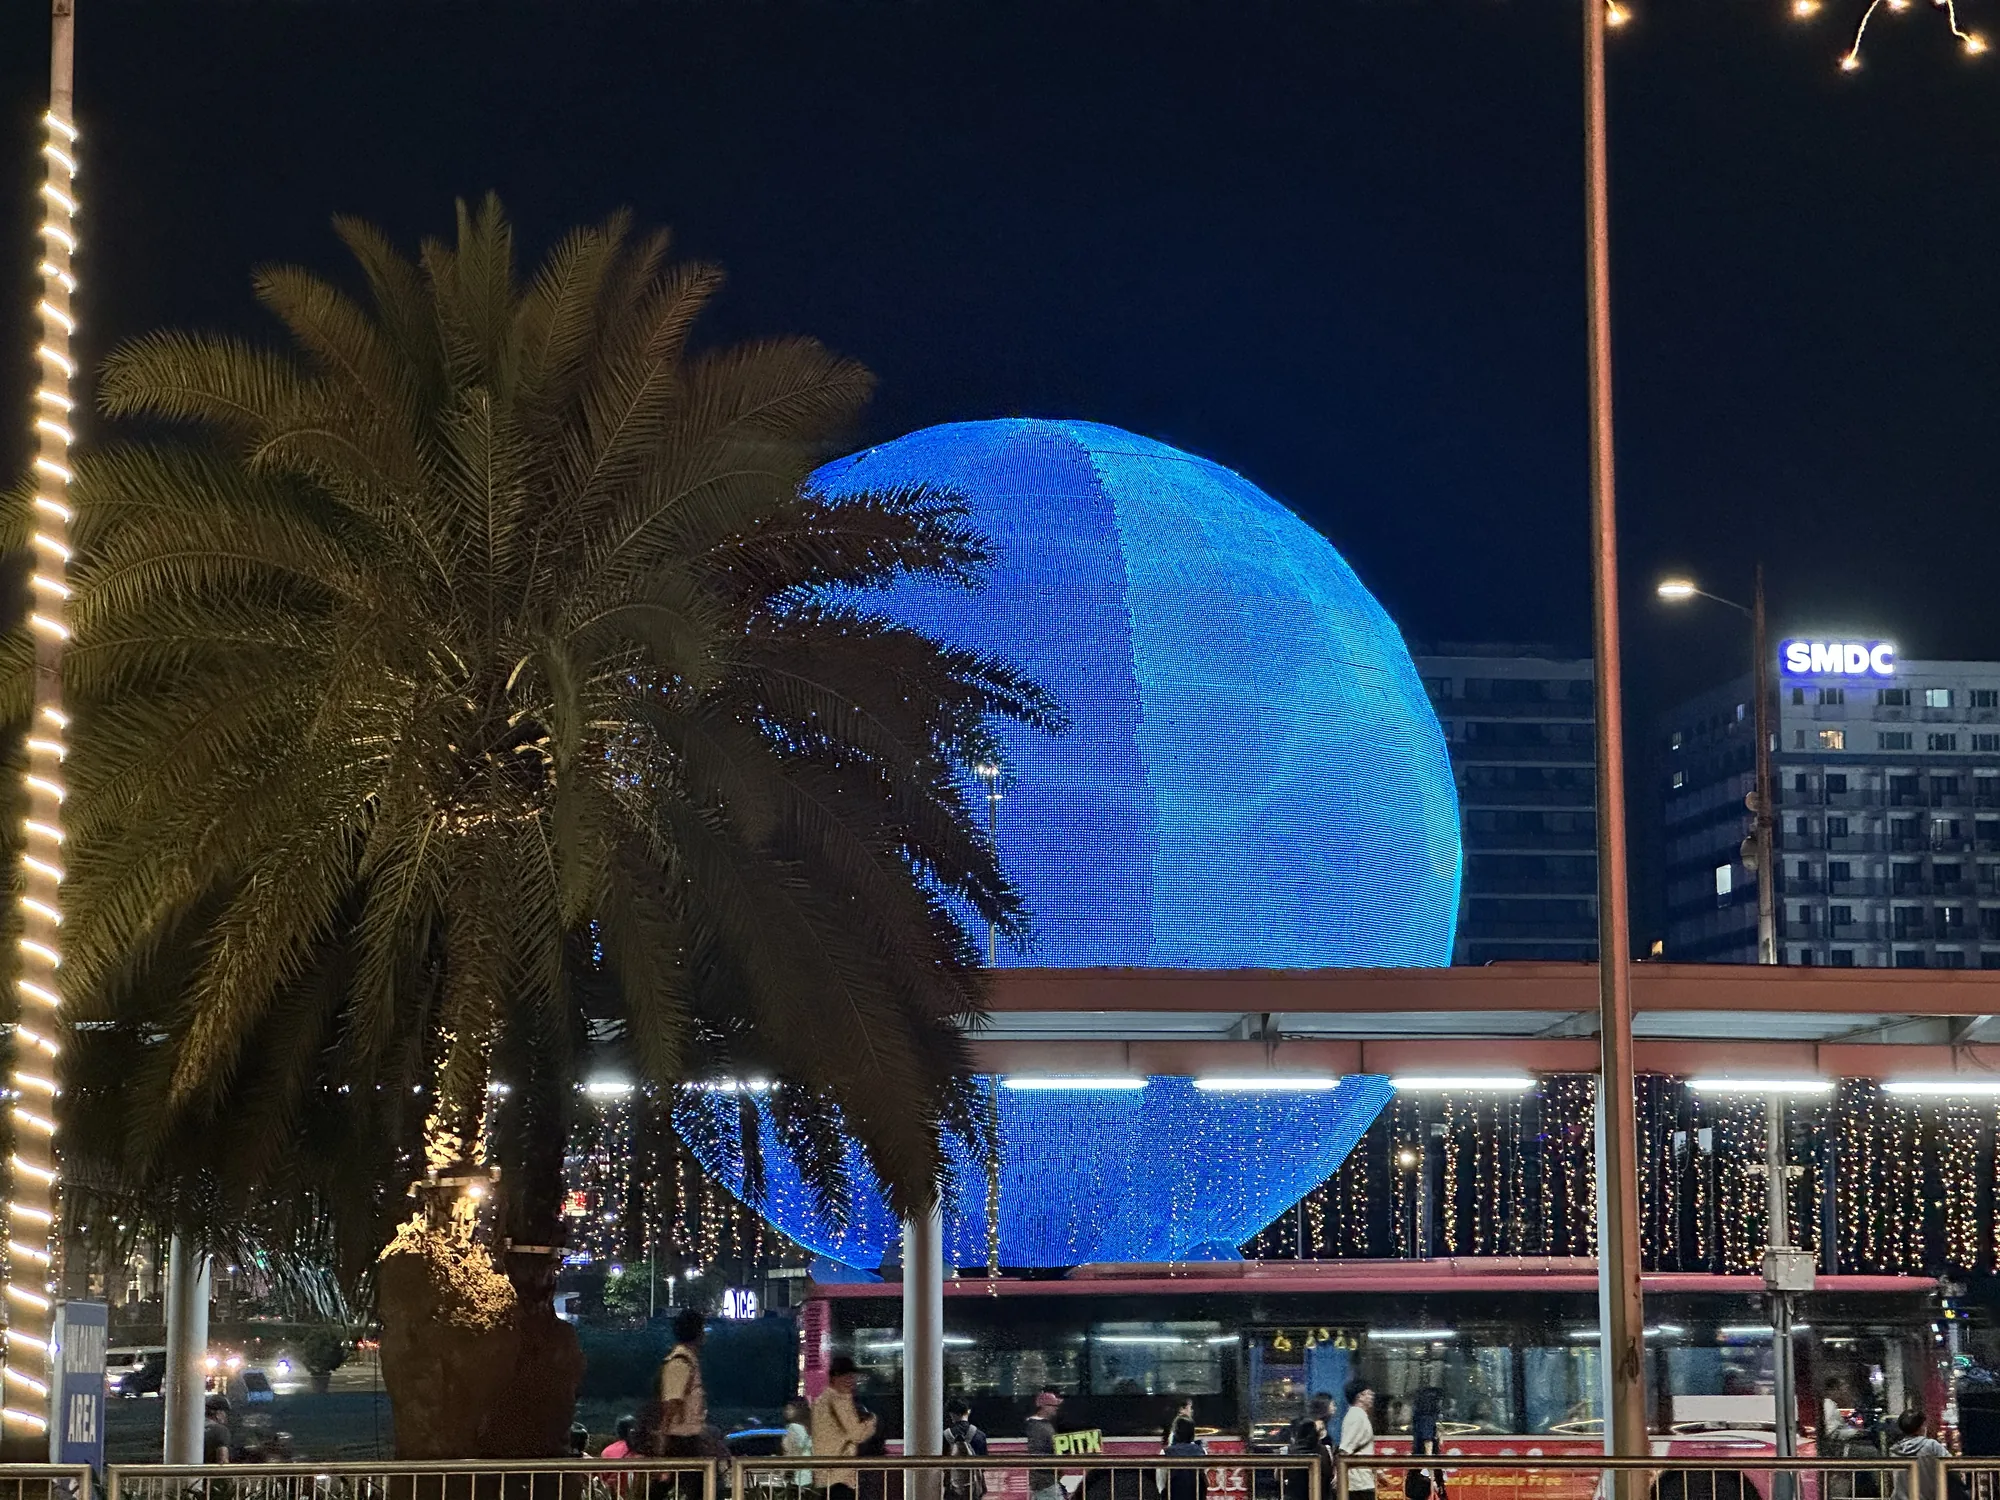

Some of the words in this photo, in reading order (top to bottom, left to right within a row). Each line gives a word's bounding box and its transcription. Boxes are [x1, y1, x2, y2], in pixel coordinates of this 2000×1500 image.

[1787, 642, 1894, 674] SMDC
[68, 1394, 97, 1442] AREA
[1055, 1431, 1102, 1456] PITX
